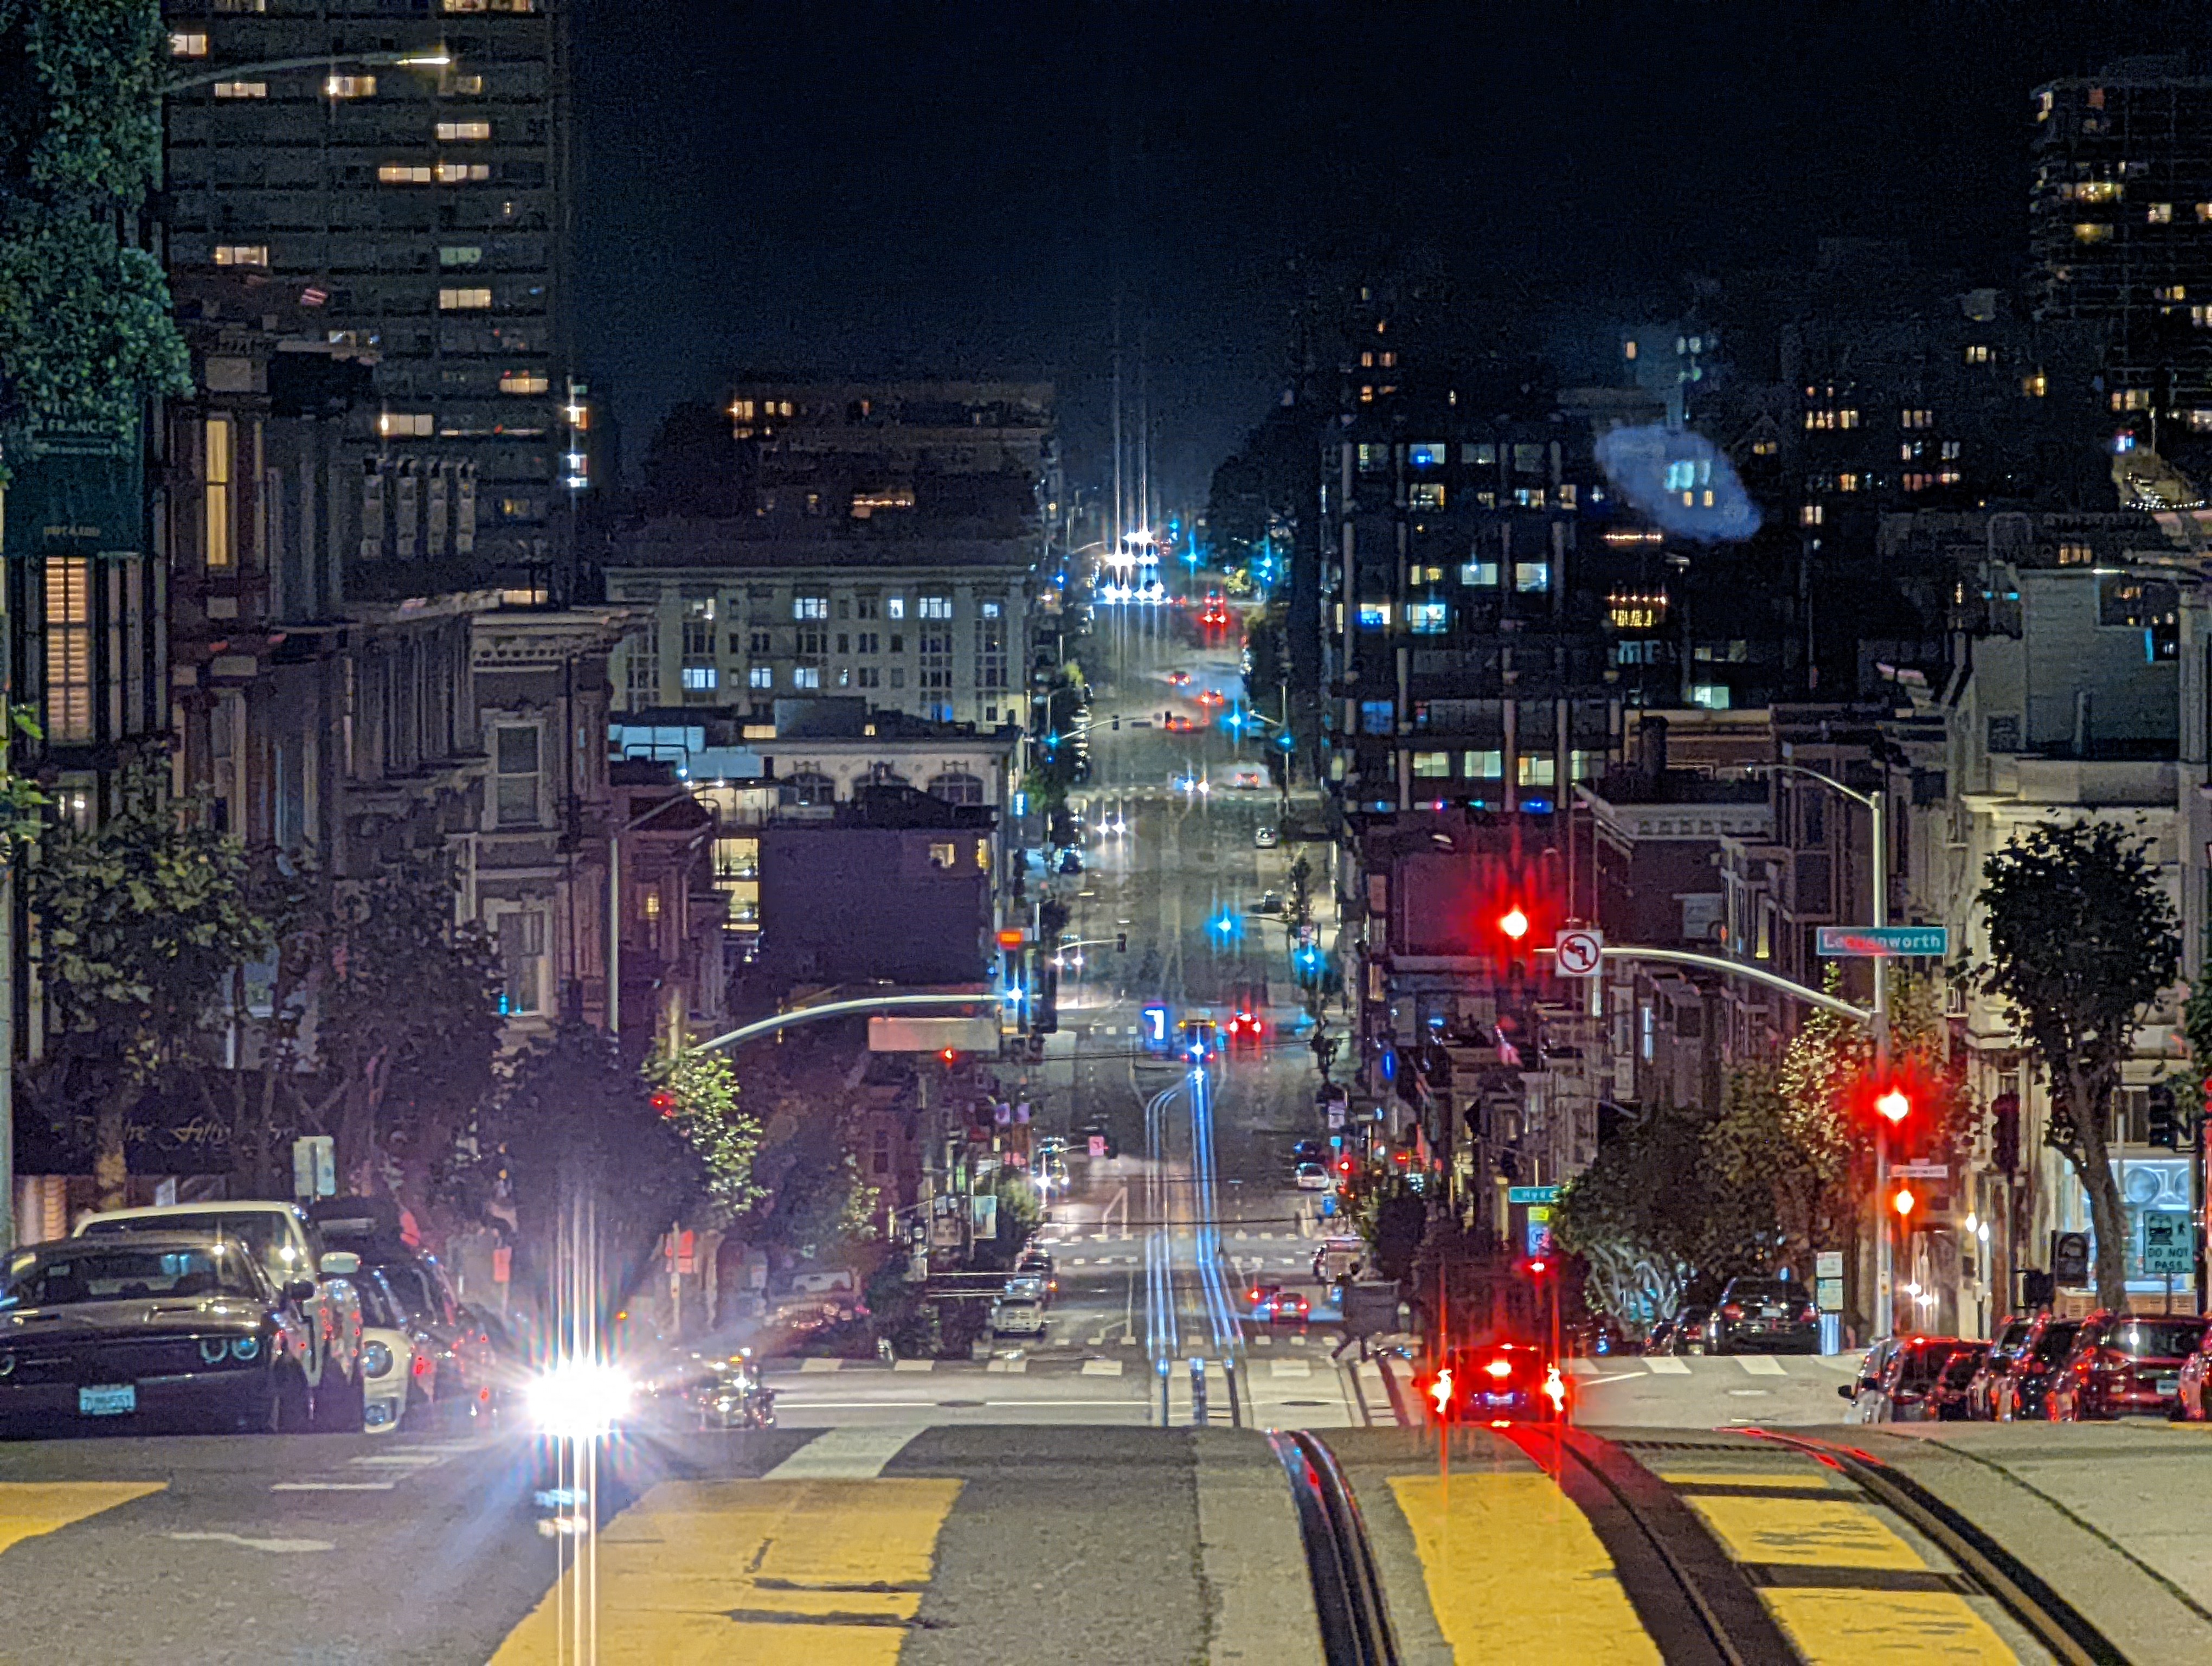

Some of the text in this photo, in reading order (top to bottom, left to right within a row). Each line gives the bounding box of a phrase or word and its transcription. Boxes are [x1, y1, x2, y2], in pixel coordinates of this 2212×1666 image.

[1823, 933, 1940, 948] Leavenworth
[2148, 1248, 2188, 1257] DO NOT
[2155, 1260, 2182, 1270] PASS
